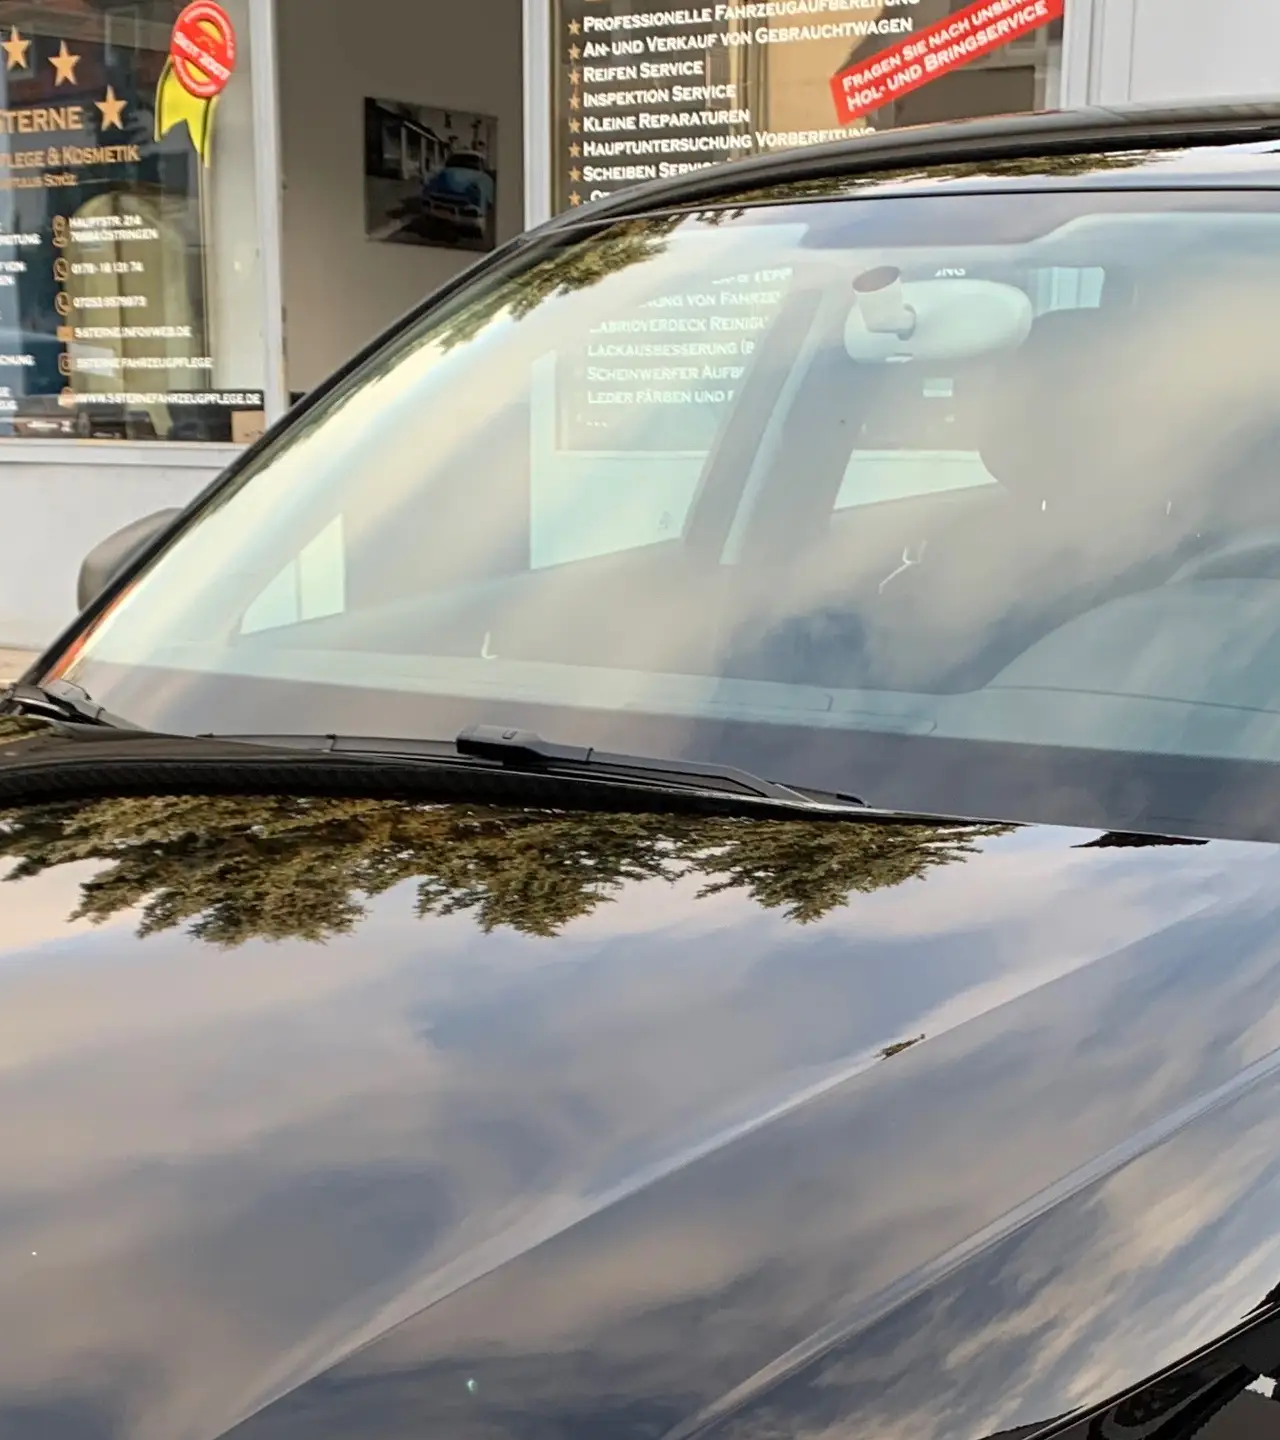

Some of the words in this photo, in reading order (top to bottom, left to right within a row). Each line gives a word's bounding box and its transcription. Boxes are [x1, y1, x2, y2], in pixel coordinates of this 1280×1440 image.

[583, 8, 712, 32] PROFESSIONELLE
[612, 40, 644, 56] UND
[646, 33, 718, 52] VERKAUF
[720, 31, 753, 46] VON
[755, 17, 913, 44] GEBRAUCHTWAGEN
[841, 53, 902, 92] FRAGEN
[902, 38, 929, 61] SIE
[928, 17, 970, 49] NACH
[846, 86, 887, 112] HOL-
[886, 63, 923, 91] UND
[923, 0, 1049, 73] BRINGSERVICE
[583, 66, 637, 83] REIFEN
[640, 61, 704, 79] SERVICE
[583, 88, 669, 107] INSPEKTION
[672, 84, 737, 102] SERVICE
[583, 115, 637, 132] KLEINE
[639, 109, 750, 129] REPARATUREN
[63, 144, 142, 165] KOSMETIK
[583, 134, 752, 157] HAUPTUNTERSUCHUNG
[583, 164, 657, 182] SCHEIBEN
[694, 389, 725, 403] UND
